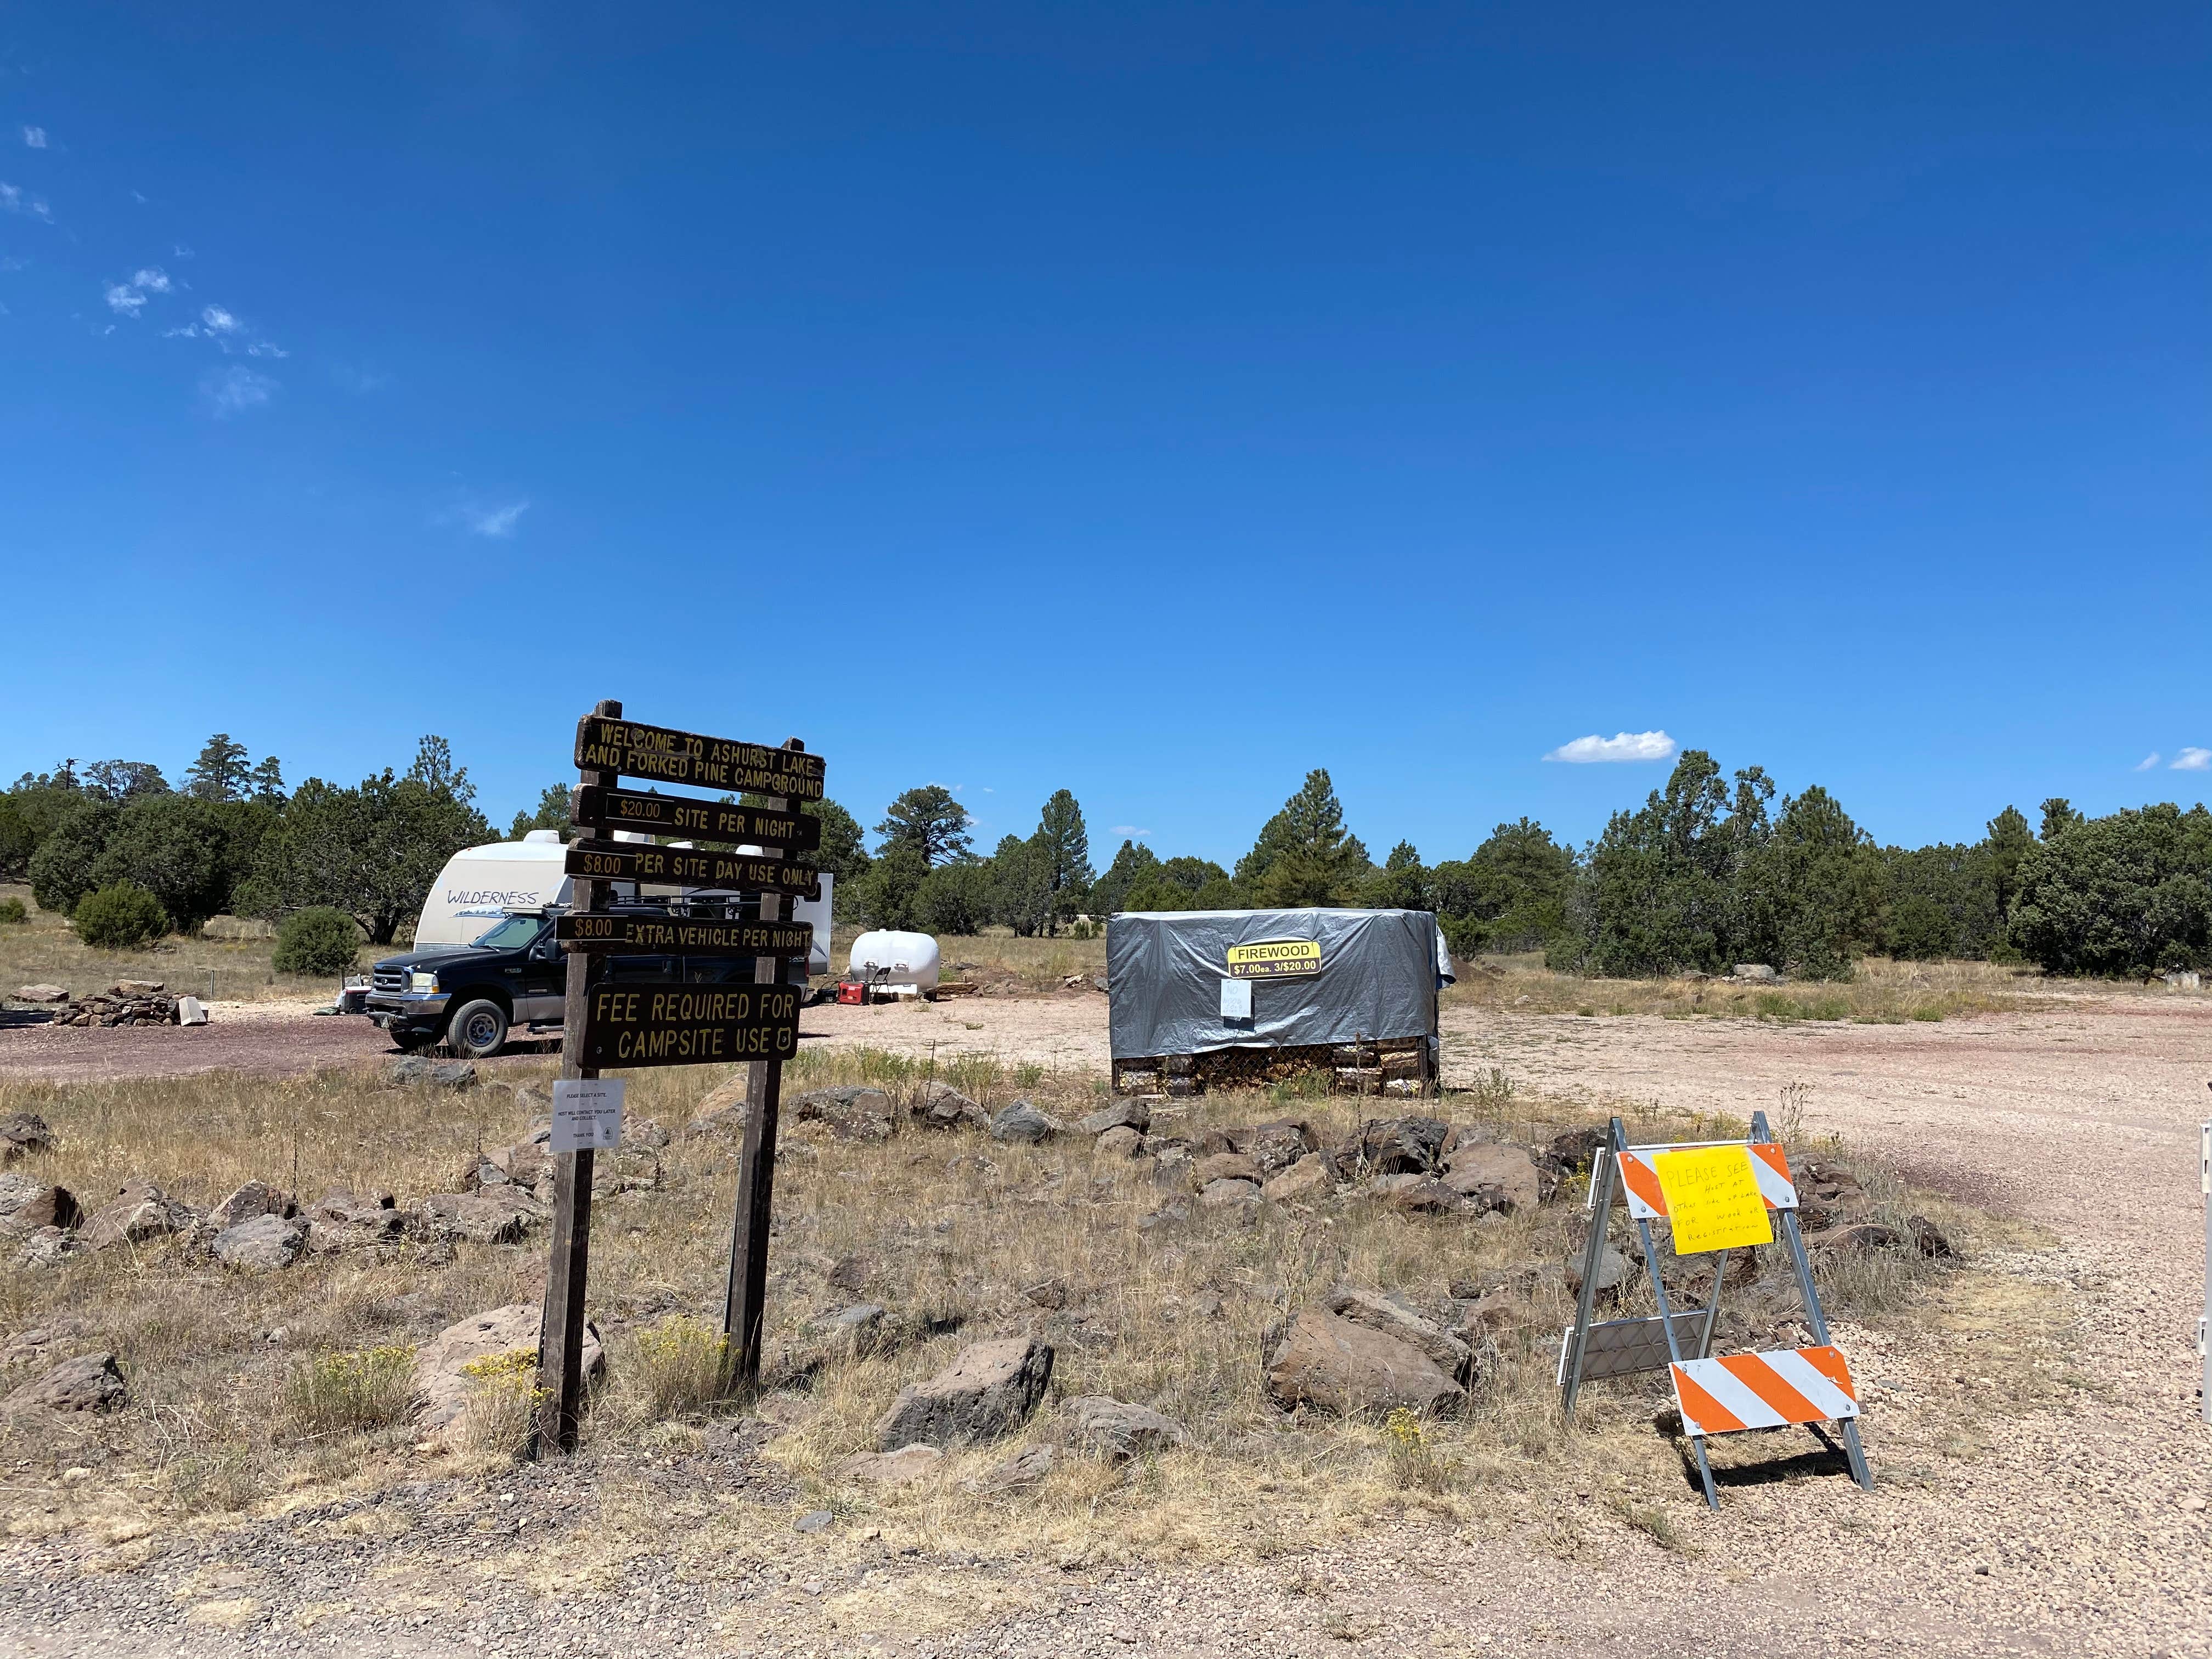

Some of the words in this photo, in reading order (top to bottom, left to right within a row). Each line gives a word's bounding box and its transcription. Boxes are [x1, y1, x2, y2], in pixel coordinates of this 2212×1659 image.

[601, 724, 677, 754] WELCOME
[685, 737, 704, 757] TO
[711, 744, 776, 769] ASHURST
[782, 755, 813, 776] LAKE
[585, 744, 620, 766] AND
[627, 751, 688, 777] FORKED
[695, 762, 727, 783] PINE
[735, 768, 822, 798] CAMPGROUND
[620, 799, 660, 818] $20.00
[674, 808, 708, 830] SITE
[719, 813, 745, 833] PER
[755, 817, 795, 839] NIGHT
[583, 854, 621, 874] $8.00
[635, 853, 664, 874] PER
[673, 857, 707, 878] SITE
[716, 860, 742, 880] DAY
[749, 865, 775, 883] USE
[782, 870, 815, 887] ONLY
[448, 890, 539, 905] WILDERNESS
[575, 918, 612, 937] $8.00
[625, 923, 674, 945] EXTRA
[679, 927, 738, 946] VEHICLE
[743, 930, 768, 947] PER
[773, 930, 810, 948] NIGHT
[1238, 945, 1310, 960] FIREWOOD
[1274, 960, 1316, 972] 3/$20.00
[1227, 985, 1238, 994] NO
[597, 994, 640, 1022] FEE
[651, 993, 749, 1022] REQUIRED
[760, 994, 794, 1019] FOR
[618, 1028, 724, 1058] CAMPSITE
[736, 1027, 771, 1053] USE
[1666, 1166, 1718, 1189] PLEASE
[1727, 1161, 1749, 1177] SEE
[1733, 1179, 1743, 1188] AT
